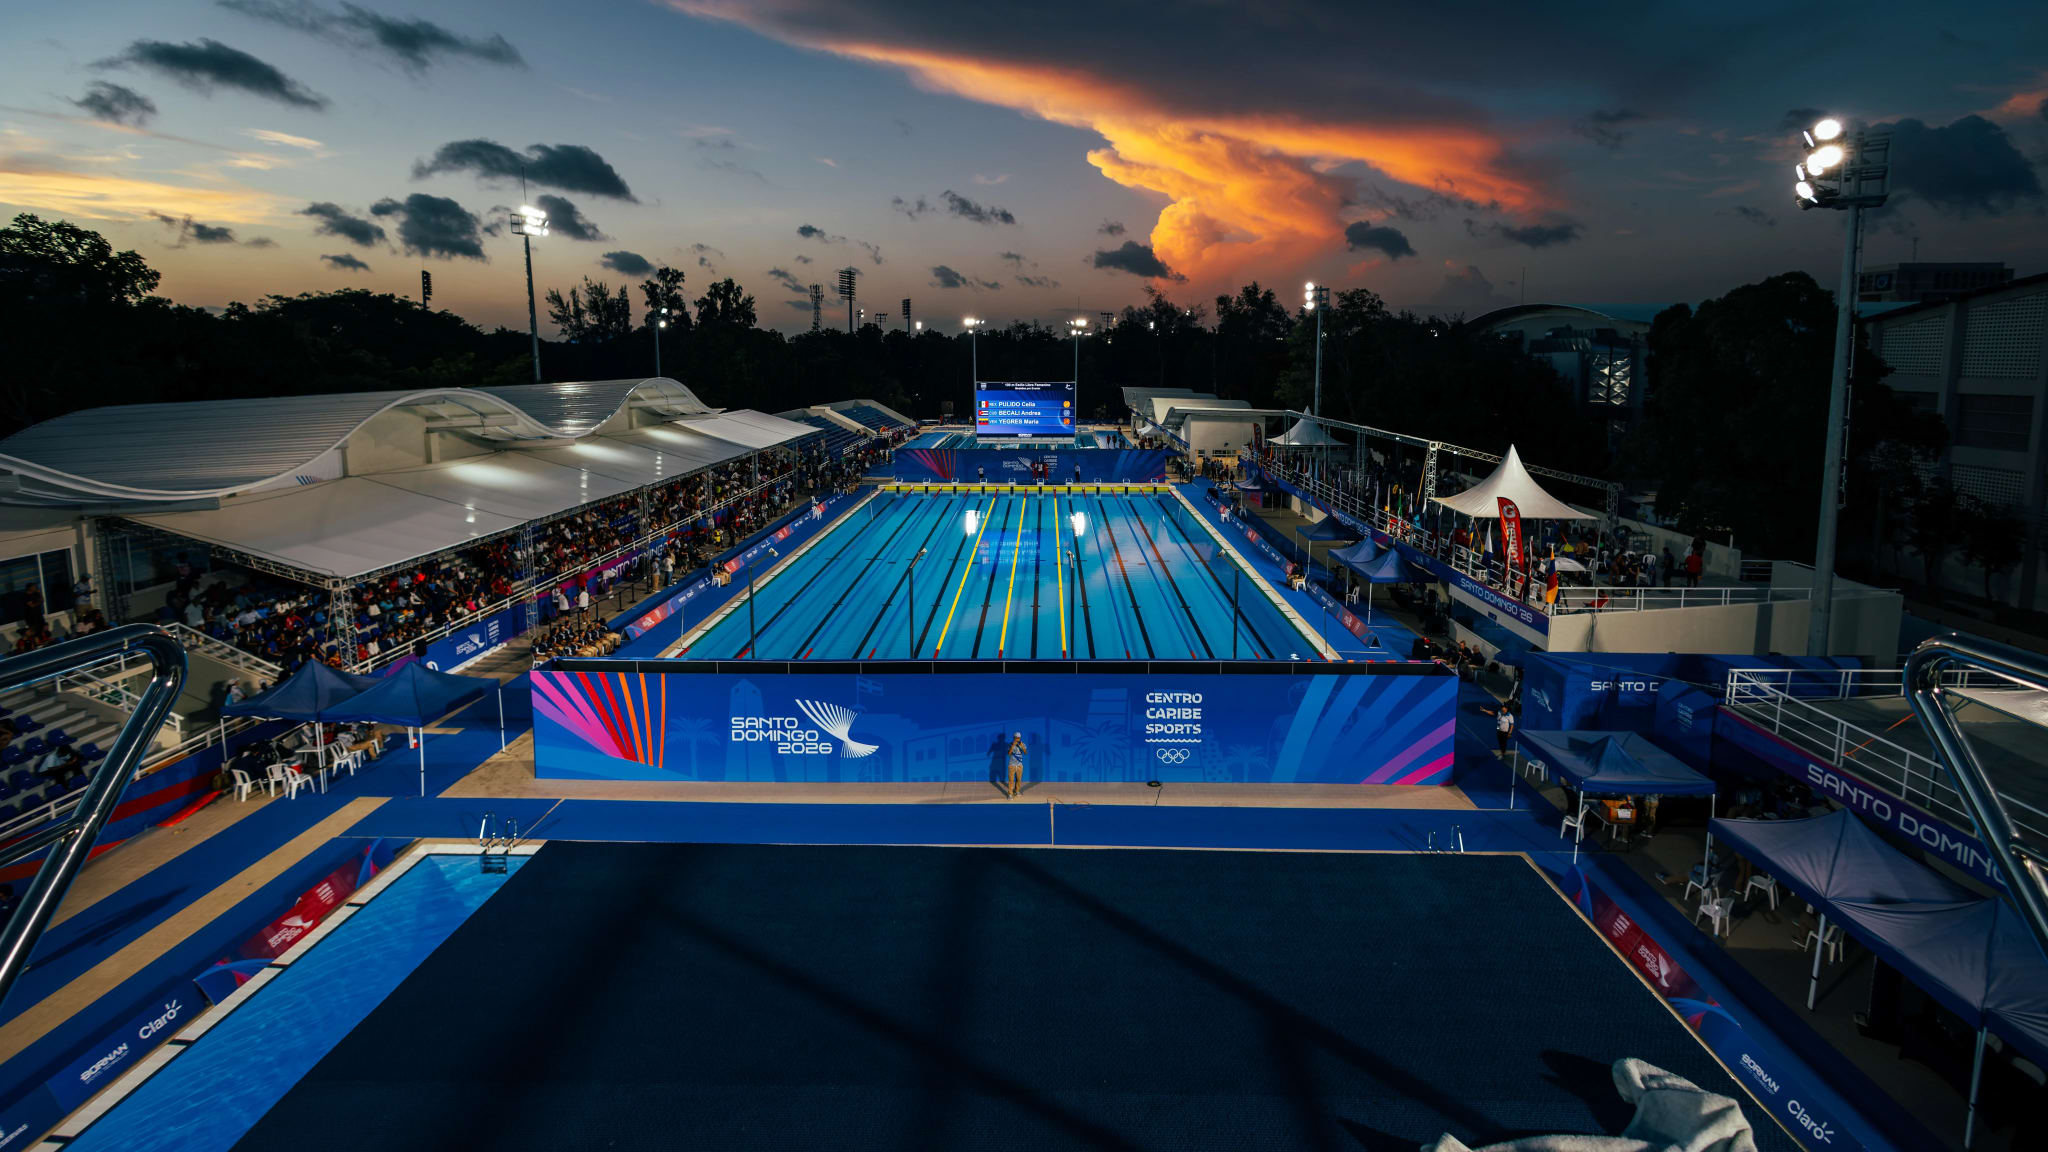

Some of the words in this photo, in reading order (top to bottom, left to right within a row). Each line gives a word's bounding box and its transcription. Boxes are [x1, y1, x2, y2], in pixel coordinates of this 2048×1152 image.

[1461, 578, 1484, 597] SANTO
[1484, 590, 1518, 615] DOMINGO
[1590, 681, 1646, 692] SANTO
[1145, 692, 1203, 704] CENTRO
[1145, 707, 1202, 720] CARIBE
[731, 717, 799, 729] SANTO
[1145, 723, 1202, 734] SPORTS
[731, 730, 819, 742] DOMINGO
[777, 742, 833, 755] 2026
[1807, 763, 1892, 822] SANTO
[1899, 812, 2005, 886] DOMIN
[139, 1004, 179, 1039] Claro
[80, 1042, 128, 1081] BORNAN
[1741, 1053, 1780, 1093] BORNAN
[1787, 1099, 1829, 1141] Claro
